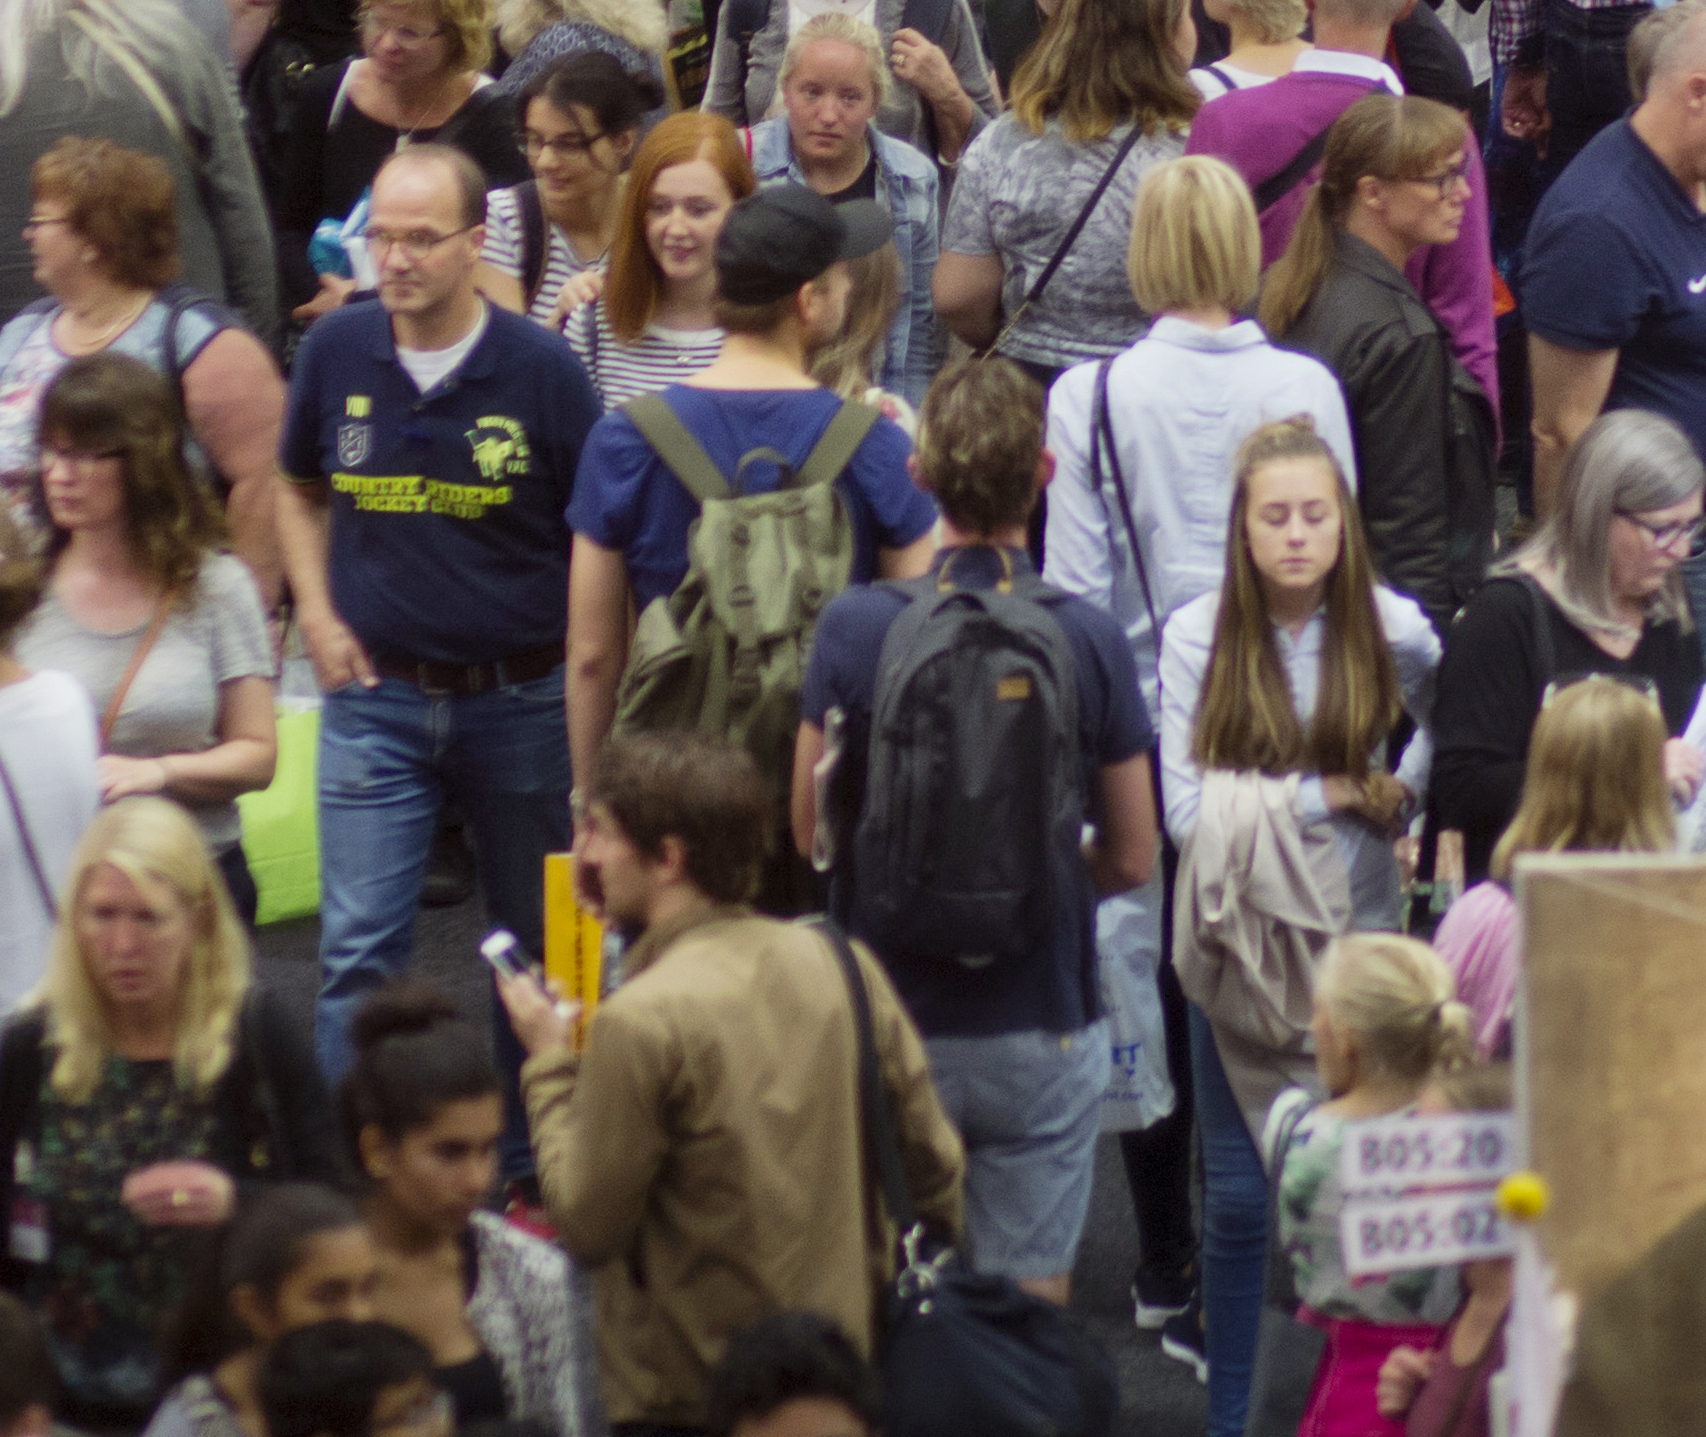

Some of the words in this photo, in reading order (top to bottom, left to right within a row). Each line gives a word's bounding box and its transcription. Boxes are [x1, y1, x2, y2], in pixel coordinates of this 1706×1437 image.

[331, 472, 425, 496] COUNTRY
[426, 478, 513, 505] RIDERS
[354, 494, 428, 512] JOCKEY
[1359, 1129, 1503, 1176] B05:20
